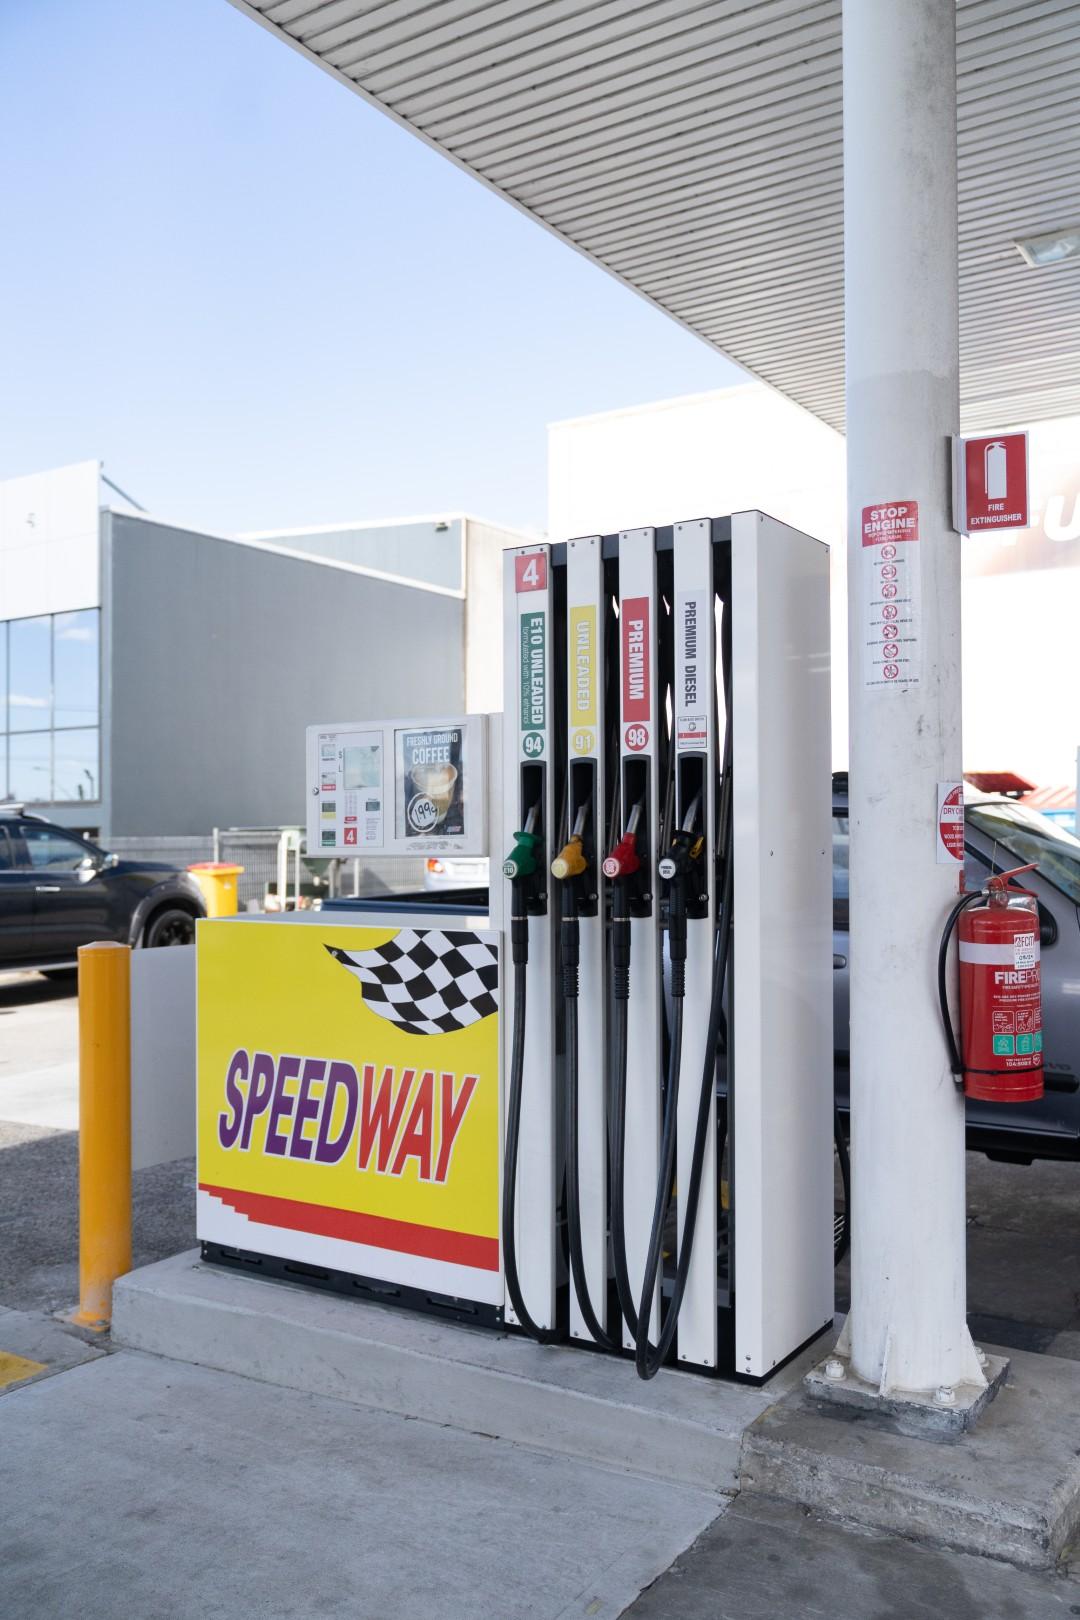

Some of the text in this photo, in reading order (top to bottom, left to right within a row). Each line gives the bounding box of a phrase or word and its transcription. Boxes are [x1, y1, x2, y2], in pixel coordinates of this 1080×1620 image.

[871, 507, 907, 521] STOP
[988, 503, 1004, 511] FIRE
[864, 517, 915, 533] ENGINE
[971, 513, 1022, 525] EXTINGUISHER
[522, 559, 539, 585] 4
[684, 601, 697, 659] PREMIUM
[522, 626, 530, 663] formulated
[576, 621, 590, 711] UNLEADED
[628, 619, 645, 700] PREMIUM
[531, 617, 543, 724] E10 UNLEADED
[684, 665, 697, 707] DIESEL
[407, 732, 458, 747] FRESHLY GROUND
[525, 736, 542, 753] 94
[575, 735, 592, 752] 91
[628, 728, 646, 747] 98
[412, 746, 450, 765] COFFEE
[943, 807, 955, 815] DRY
[346, 829, 355, 843] 4
[218, 1047, 480, 1184] SPEEDWAY
